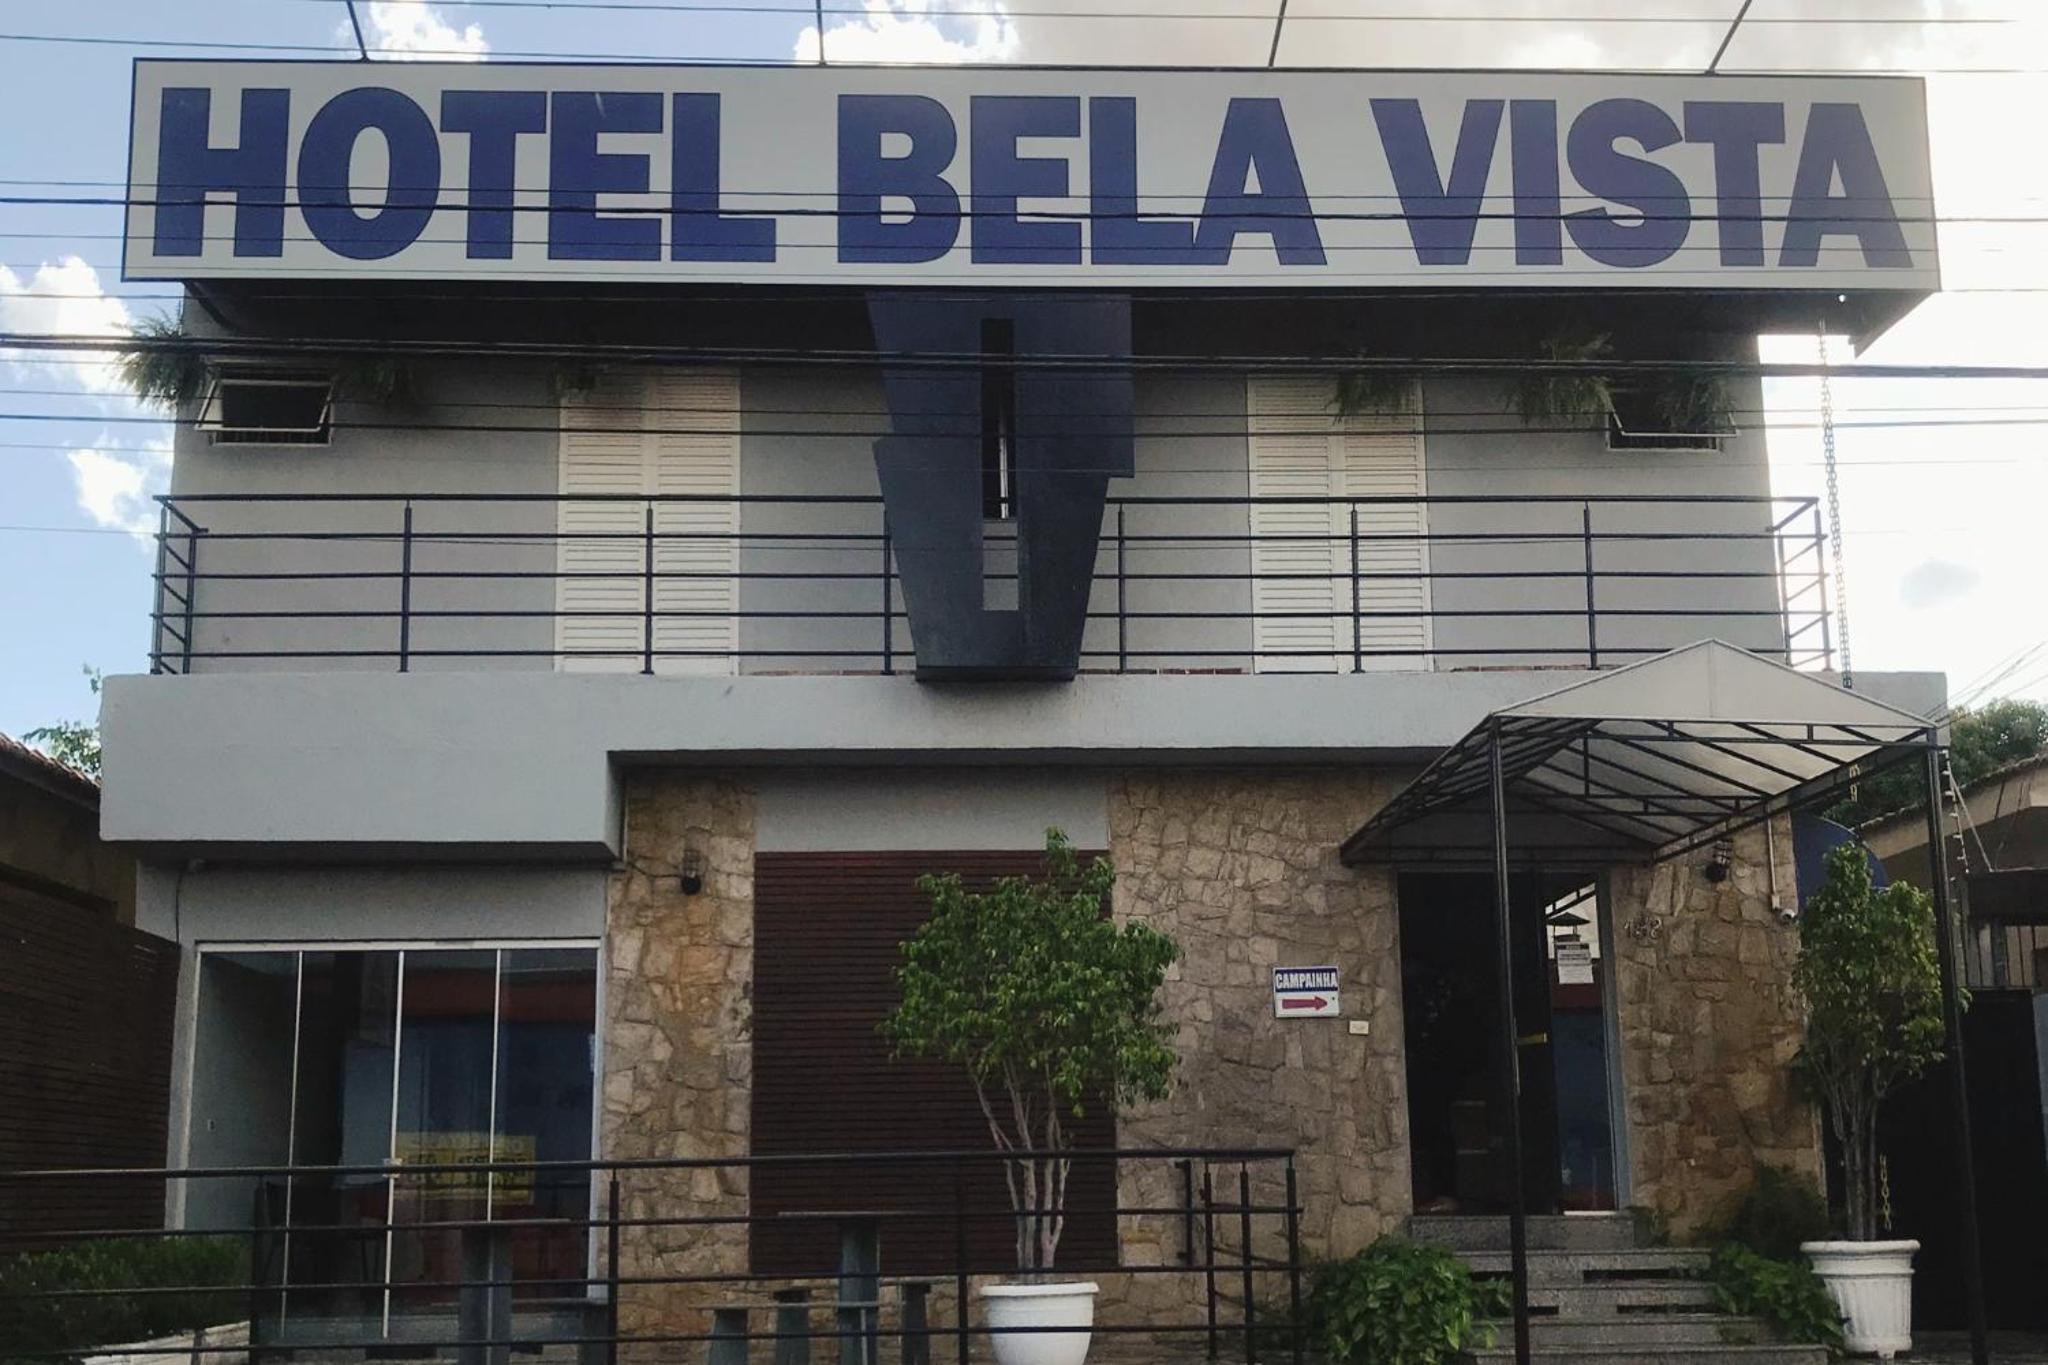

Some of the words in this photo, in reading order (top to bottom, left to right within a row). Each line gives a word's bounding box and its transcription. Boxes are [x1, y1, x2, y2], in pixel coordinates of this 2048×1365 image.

[153, 86, 776, 262] HOTEL
[838, 94, 1328, 266] BELA
[1369, 97, 1914, 268] VISTA
[1275, 971, 1338, 989] CAMPAINHA
